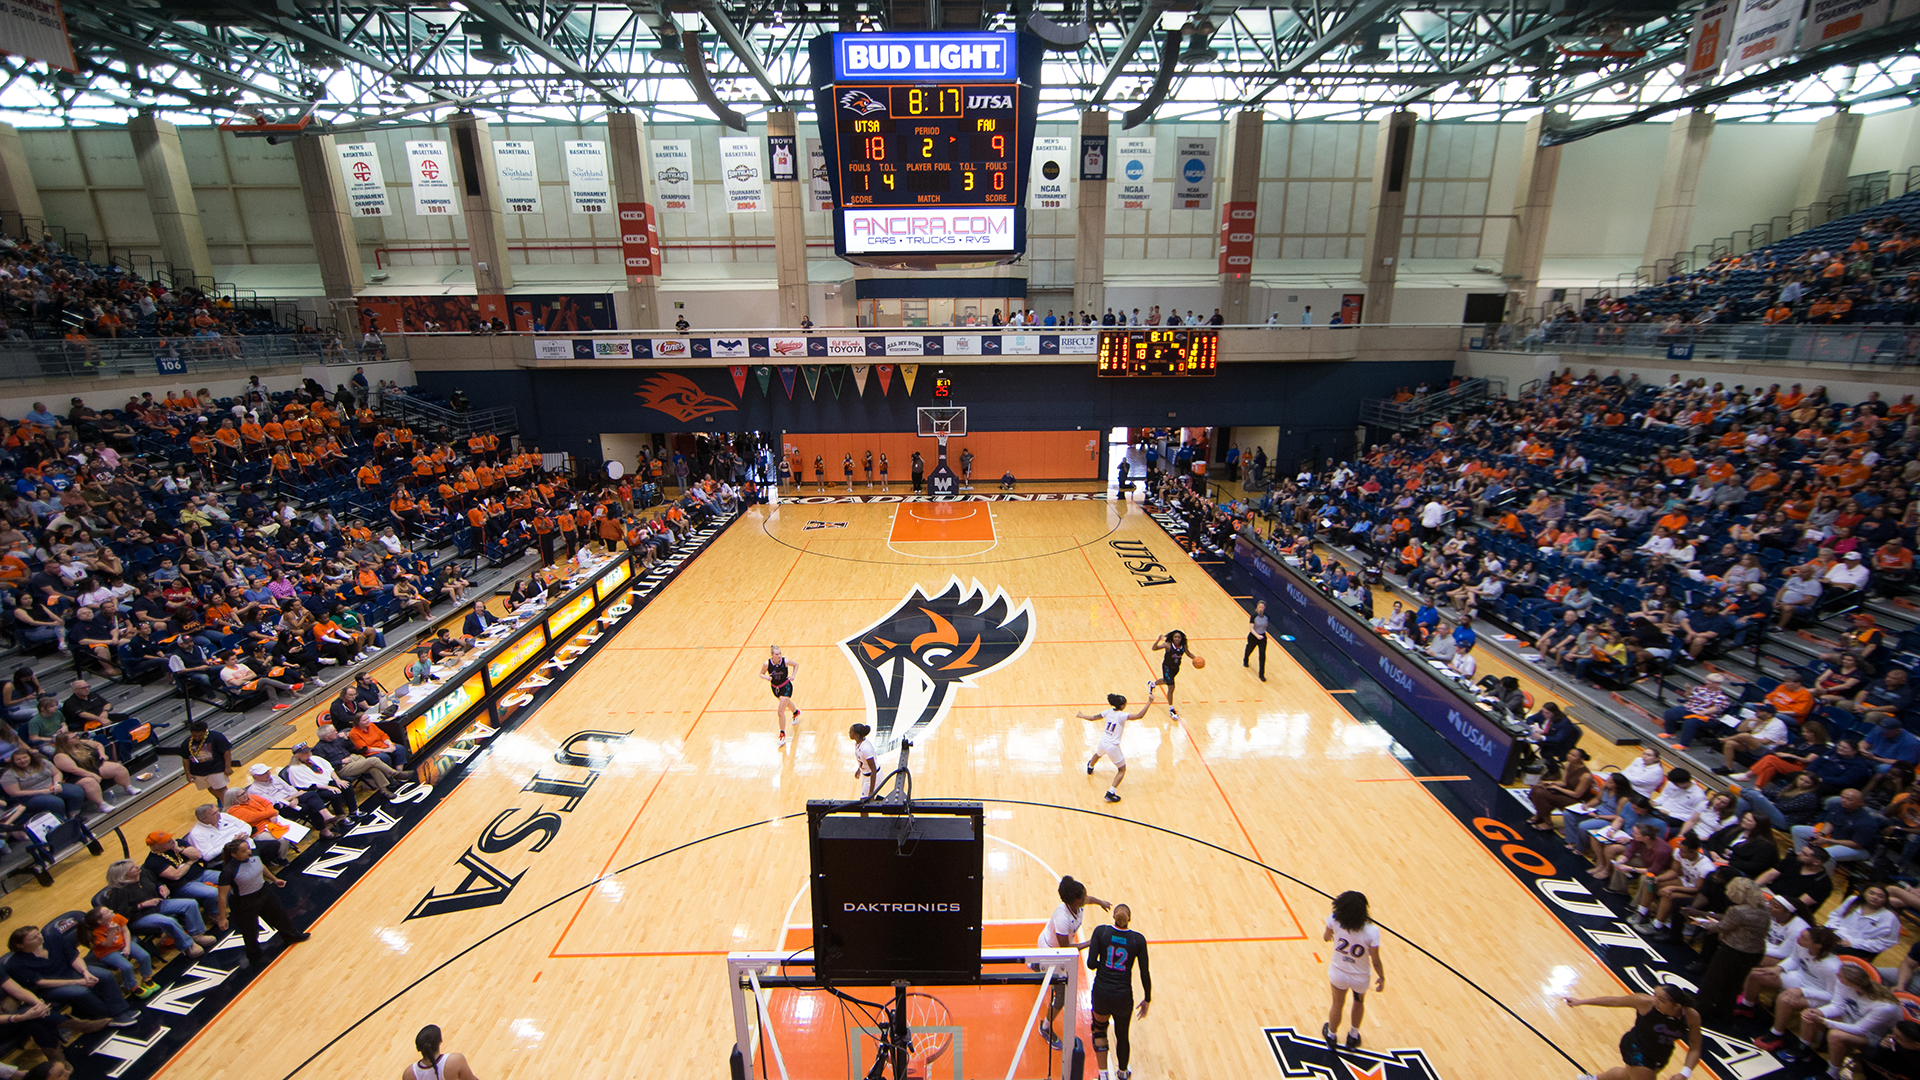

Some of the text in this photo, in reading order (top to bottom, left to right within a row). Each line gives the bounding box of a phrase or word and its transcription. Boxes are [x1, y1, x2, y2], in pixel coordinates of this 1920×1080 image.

[848, 45, 911, 70] BUD
[909, 88, 960, 114] 8:17
[967, 96, 1013, 109] UTSA
[855, 120, 880, 132] UTSA
[914, 126, 940, 136] PERIOD
[977, 119, 996, 132] FAU
[864, 136, 885, 160] 18
[922, 138, 933, 158] 2
[992, 135, 1004, 158] 9
[502, 169, 533, 177] Southland
[572, 169, 603, 177] Southland
[849, 164, 870, 172] FOULS
[906, 163, 952, 171] PLAYER FOUL
[883, 174, 894, 190] 4
[964, 172, 974, 191] 3
[993, 172, 1004, 190] 0
[851, 196, 872, 204] SCORE
[918, 195, 940, 203] MATCH
[985, 194, 1007, 202] SCORE
[853, 216, 1007, 236] ANCIRA.COM
[906, 236, 955, 244] TRUCKS
[1061, 338, 1089, 346] RBFCU
[1151, 331, 1173, 342] 8:17
[596, 343, 630, 353] BEATBOX
[887, 341, 898, 349] ALL
[908, 341, 922, 349] SONS
[1136, 349, 1147, 359] 18
[1154, 349, 1161, 358] 2
[1178, 348, 1186, 359] 9
[162, 362, 182, 370] 106
[936, 386, 949, 396] 25
[777, 493, 1108, 504] ROADRUNNERS
[628, 528, 718, 598] UNIVERSITY
[1108, 539, 1177, 588] UTSA
[1259, 561, 1271, 578] USAA
[1292, 589, 1309, 608] USAA
[596, 604, 632, 625] OF
[1335, 621, 1356, 645] USAA
[500, 632, 604, 707] TEXAS
[1389, 664, 1412, 693] USAA
[422, 685, 468, 727] UTSA
[1106, 721, 1117, 733] 11
[439, 720, 501, 764] AT
[1462, 721, 1493, 757] USAA
[302, 782, 434, 879] SAN
[400, 728, 636, 924] UTSA
[1472, 816, 1558, 878] GO
[843, 902, 961, 912] DAKTRONICS
[1335, 938, 1366, 958] 20
[1105, 945, 1128, 971] 12
